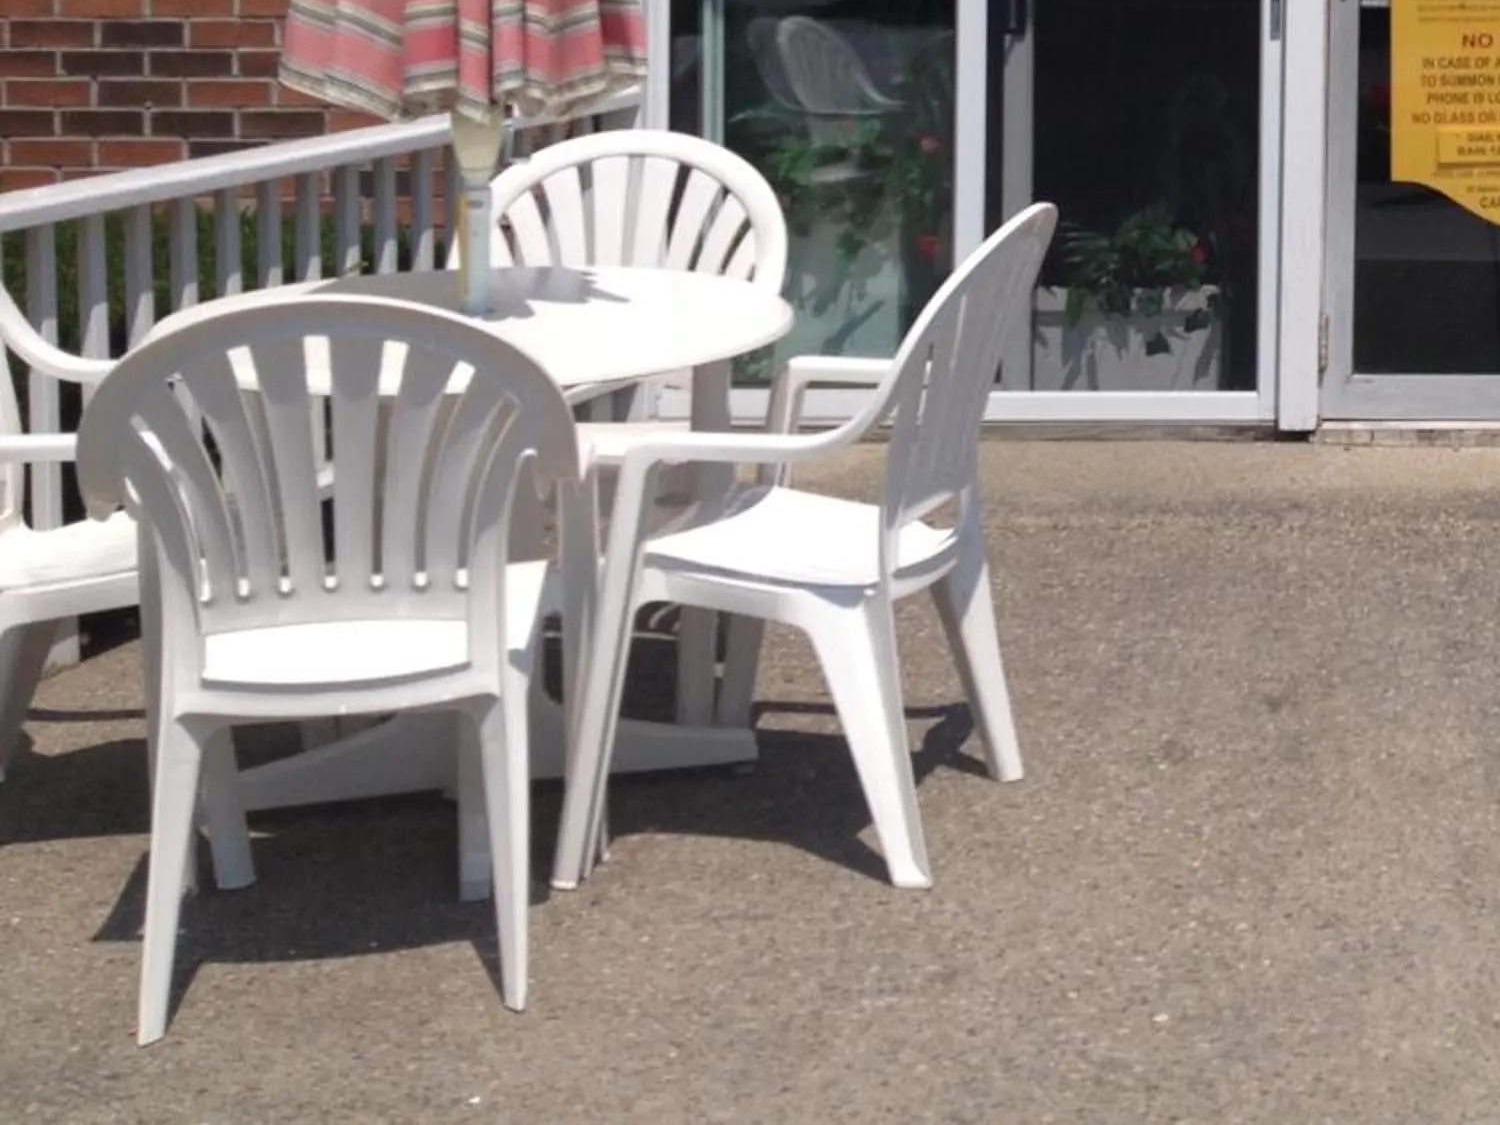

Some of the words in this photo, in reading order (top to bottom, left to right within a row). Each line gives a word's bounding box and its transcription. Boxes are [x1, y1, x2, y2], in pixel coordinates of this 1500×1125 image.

[1462, 33, 1494, 49] NO
[1422, 57, 1436, 70] IN
[1437, 56, 1472, 69] CASE
[1474, 56, 1492, 69] OF
[1420, 75, 1436, 88] TO
[1439, 74, 1495, 88] SUMMON
[1427, 92, 1470, 105] PHONE
[1473, 92, 1485, 104] IS
[1411, 112, 1431, 125] NO
[1433, 111, 1476, 124] GLASS
[1477, 111, 1497, 124] OR
